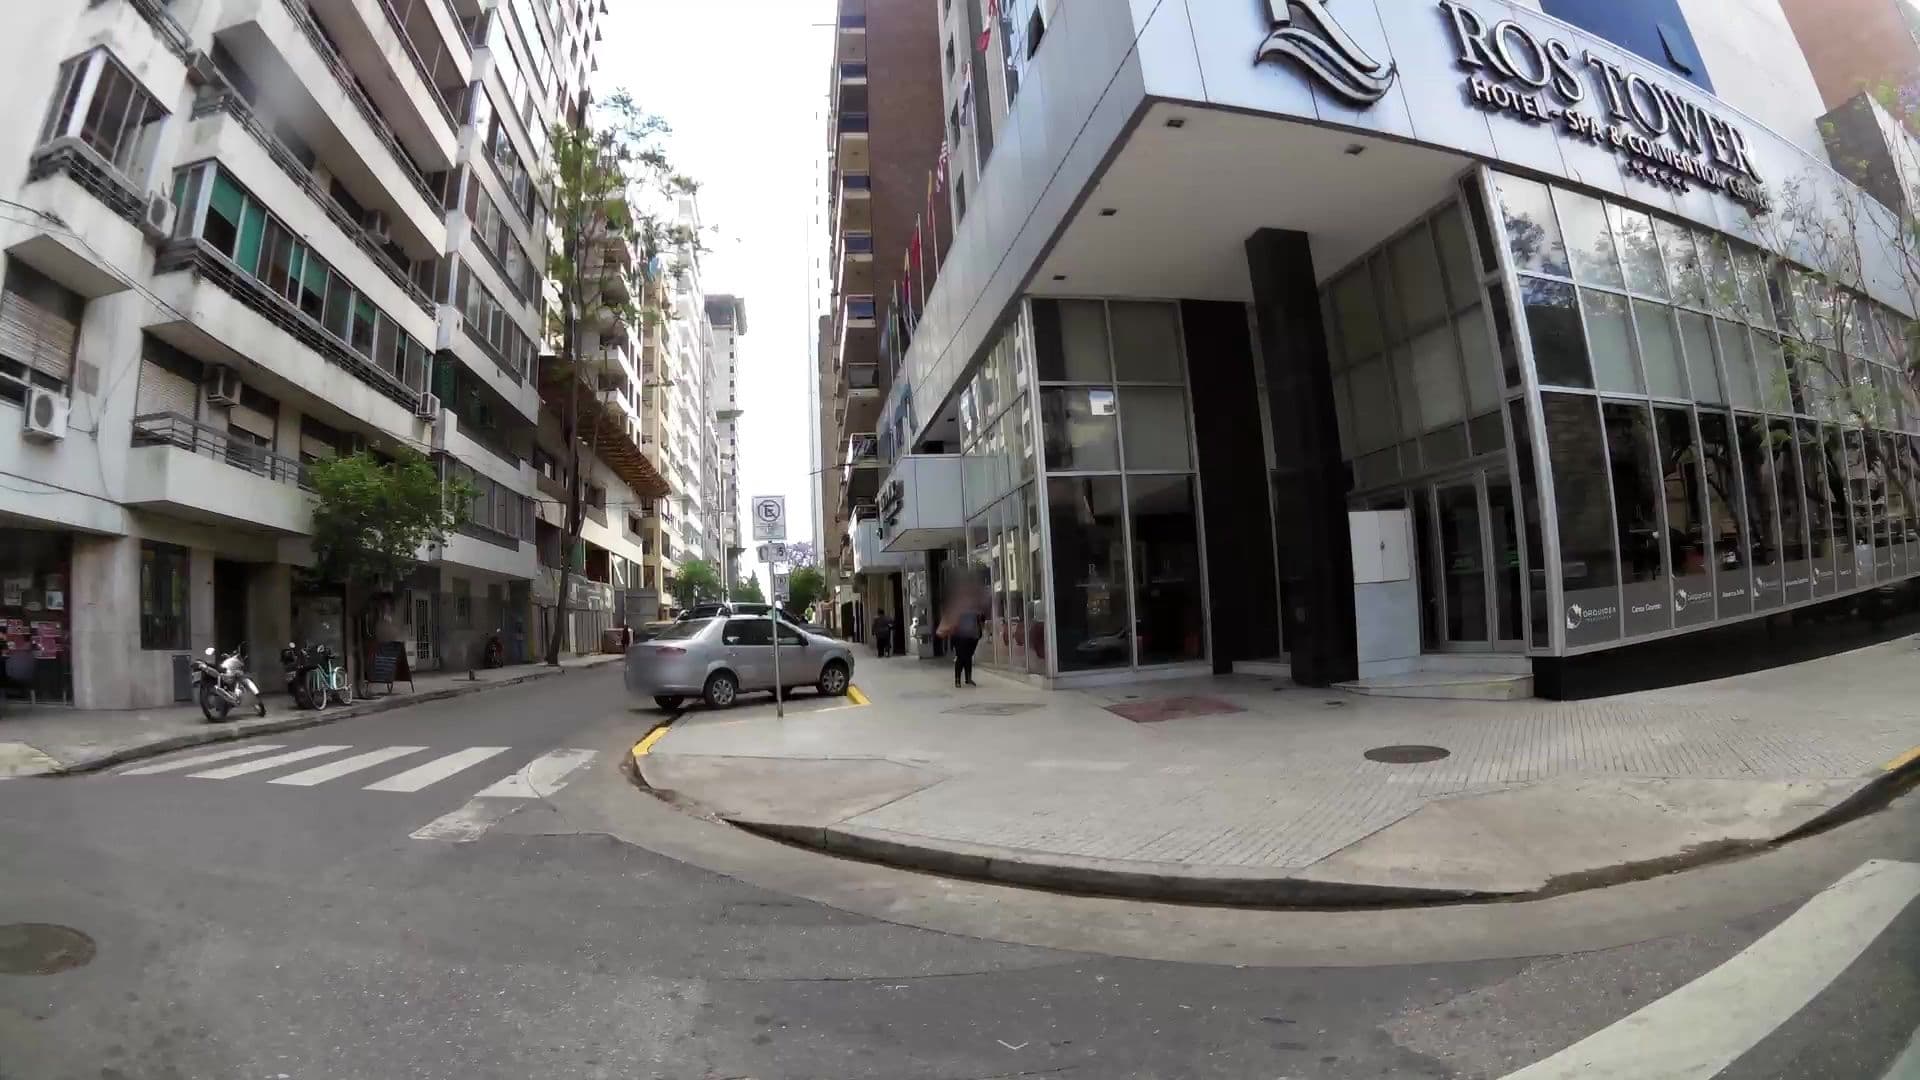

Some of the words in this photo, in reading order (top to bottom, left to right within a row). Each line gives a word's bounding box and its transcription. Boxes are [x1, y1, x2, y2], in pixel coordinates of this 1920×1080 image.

[1439, 1, 1585, 102] ROS
[1583, 50, 1764, 185] TOWER
[1467, 76, 1549, 121] HOTEL
[1566, 110, 1604, 144] SPA
[1607, 124, 1626, 149] &
[1627, 133, 1726, 188] CONVENTION
